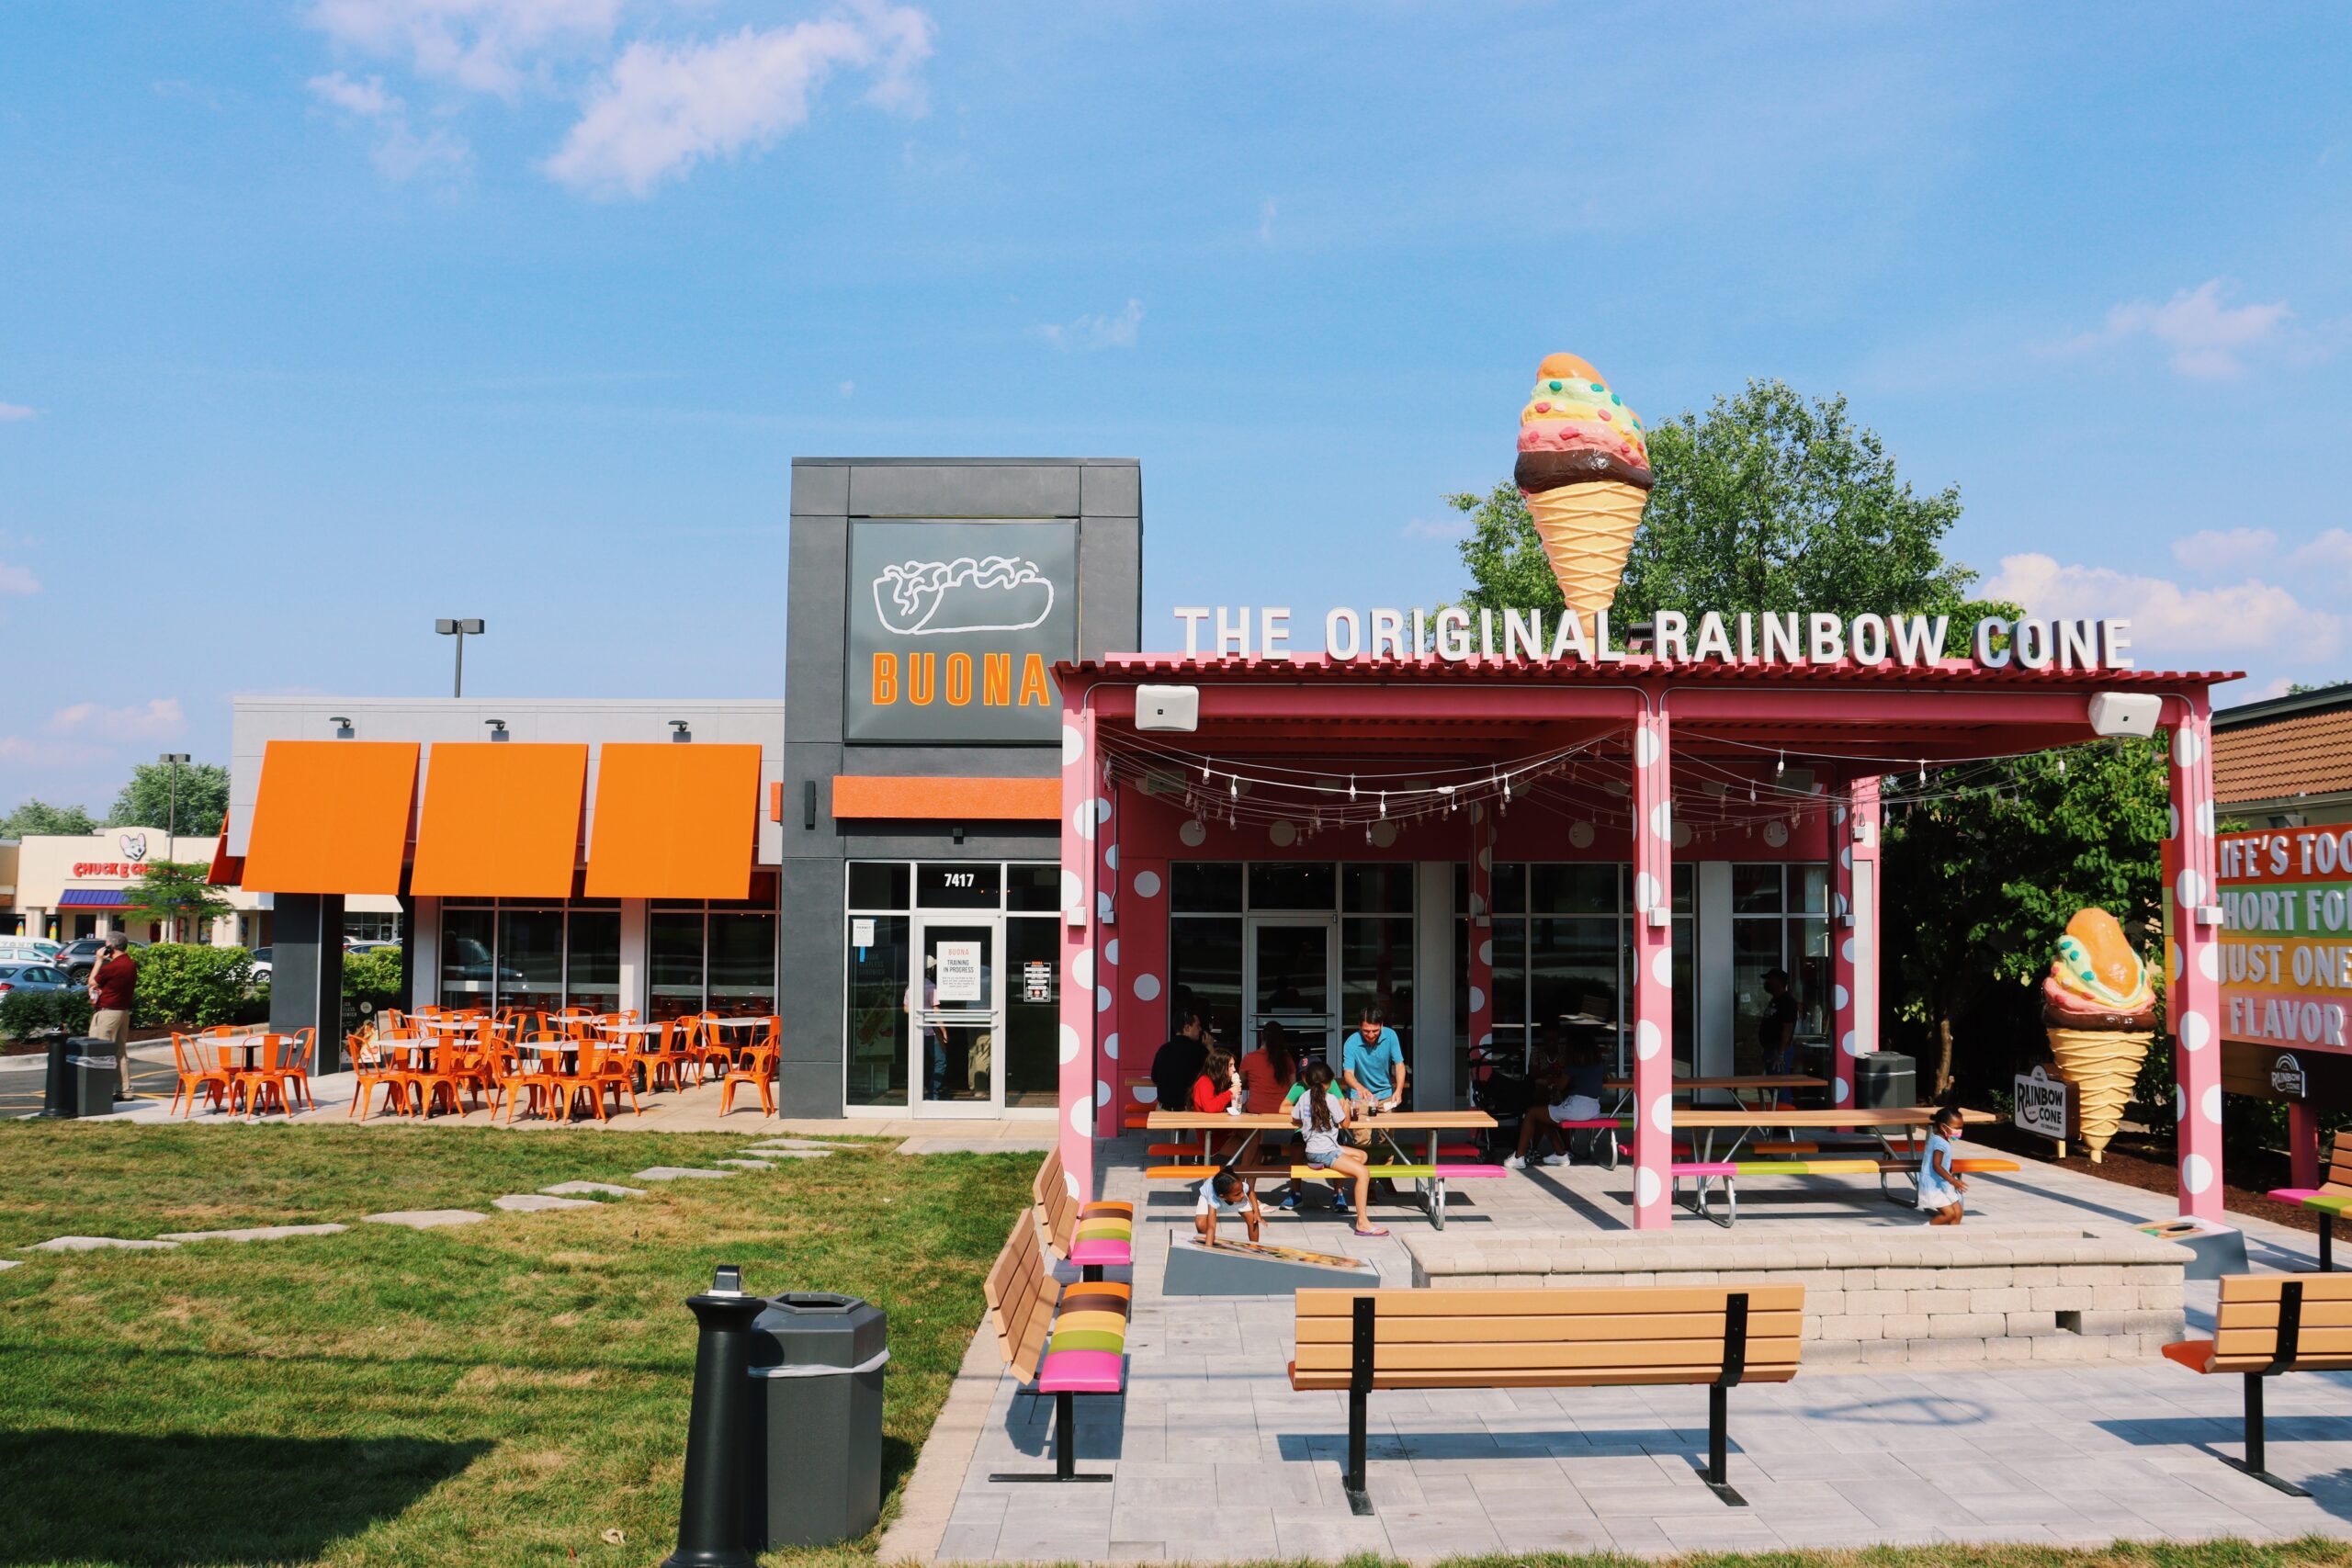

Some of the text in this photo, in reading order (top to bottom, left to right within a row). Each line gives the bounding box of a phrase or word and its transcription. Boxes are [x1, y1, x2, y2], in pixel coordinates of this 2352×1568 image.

[1174, 606, 2135, 670] THE ORIGINAL RAINBOW CONE
[872, 652, 1051, 706] BUONA
[74, 863, 119, 878] CHUCK
[119, 863, 130, 878] E
[2215, 835, 2290, 878] IFE'S
[944, 874, 974, 887] 7417
[2216, 889, 2352, 931] HORT FO
[948, 948, 969, 956] BUONA
[2292, 945, 2352, 988] ONE
[2230, 996, 2346, 1046] FLAVOR
[2271, 1071, 2301, 1088] RAINBOW
[2017, 1083, 2064, 1114] RAINBOW
[2039, 1107, 2062, 1124] CONE
